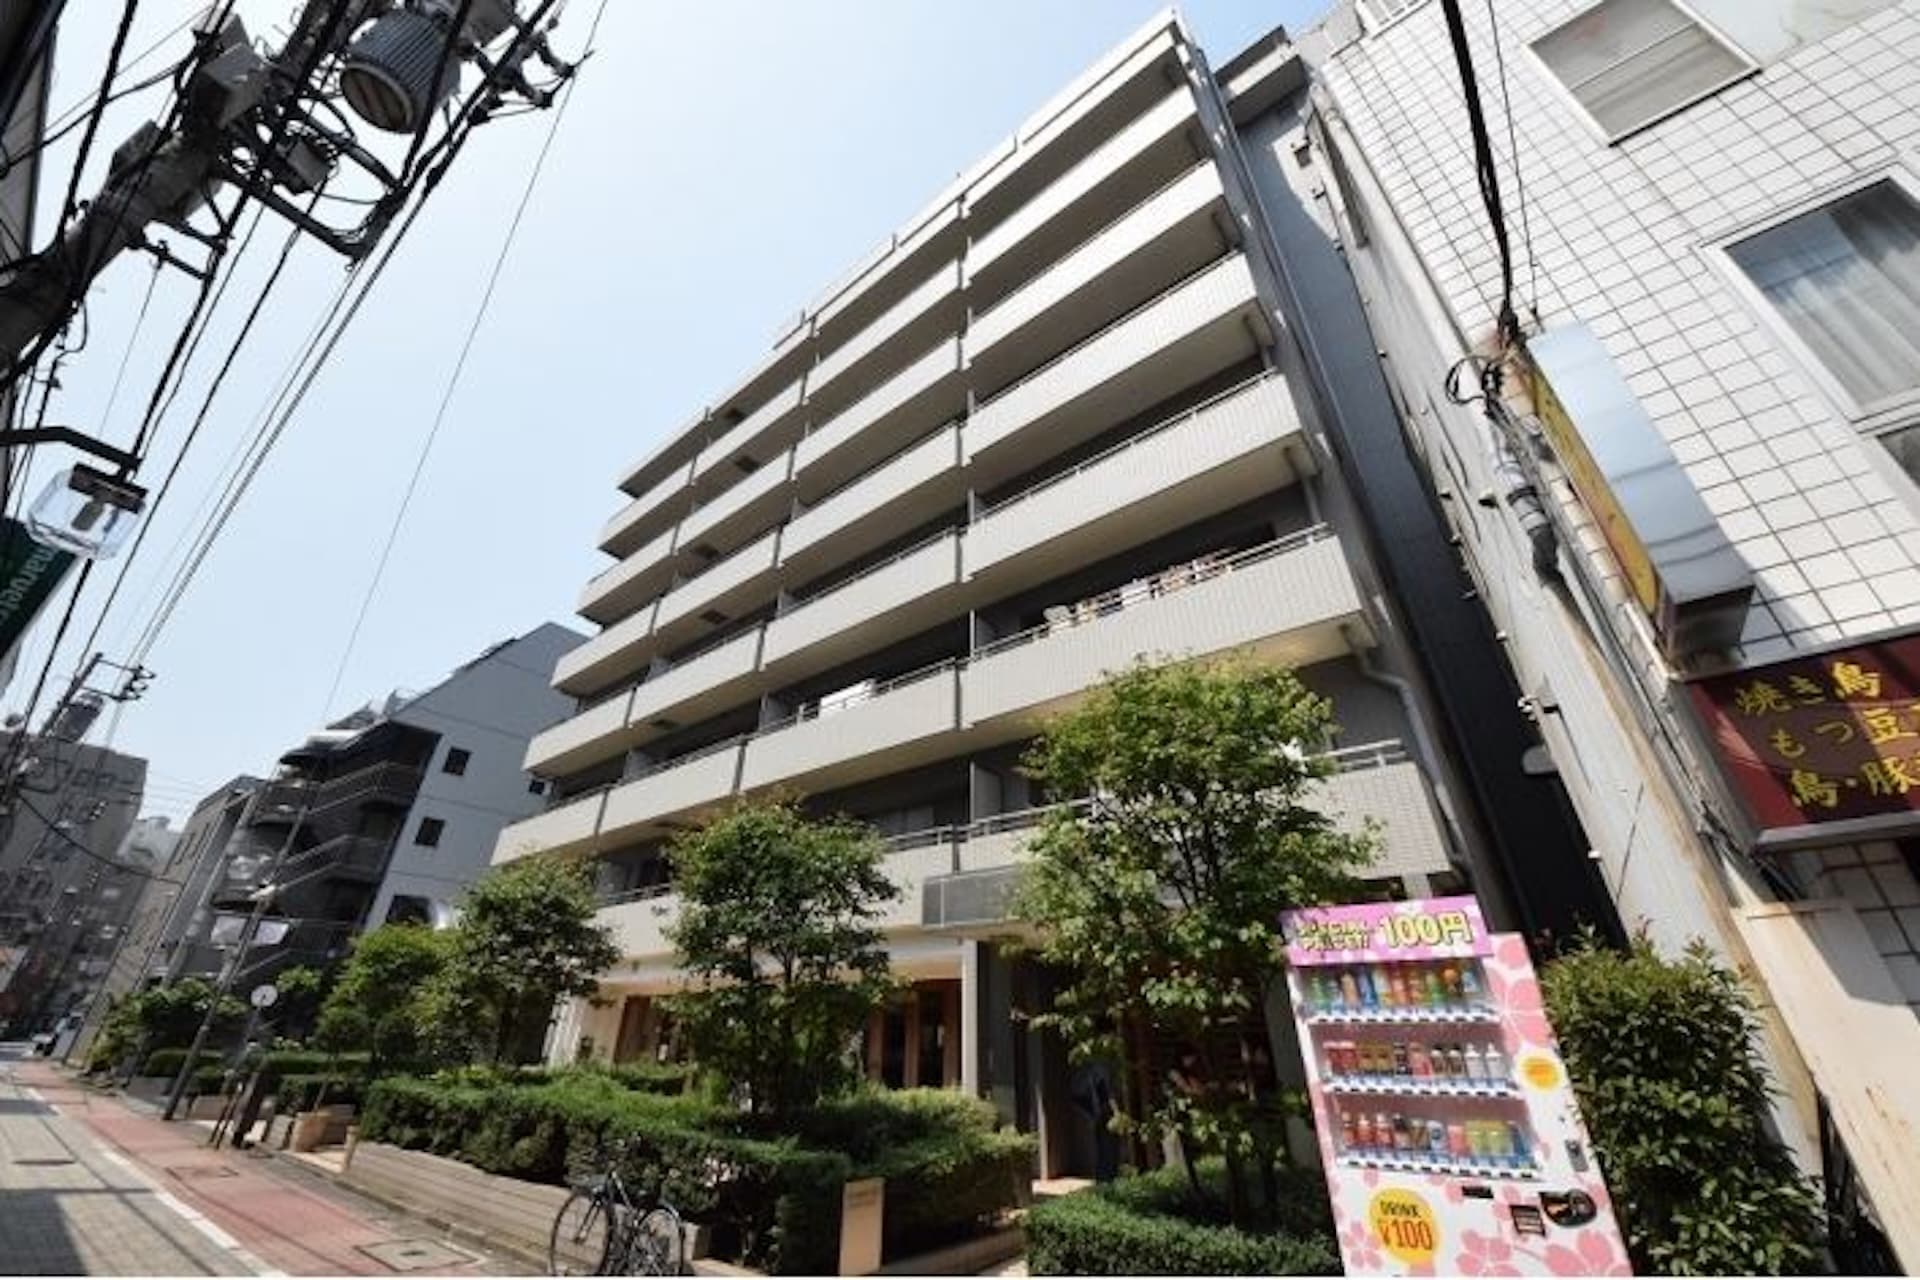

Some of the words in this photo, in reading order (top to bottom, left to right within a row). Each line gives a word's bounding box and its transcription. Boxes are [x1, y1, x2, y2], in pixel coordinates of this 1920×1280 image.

[1735, 661, 1882, 717] 焼き鳥
[1769, 703, 1920, 758] もつ豆
[1791, 749, 1920, 808] 鳥・豚
[1379, 910, 1475, 949] 100円
[1377, 1218, 1433, 1251] ¥100
